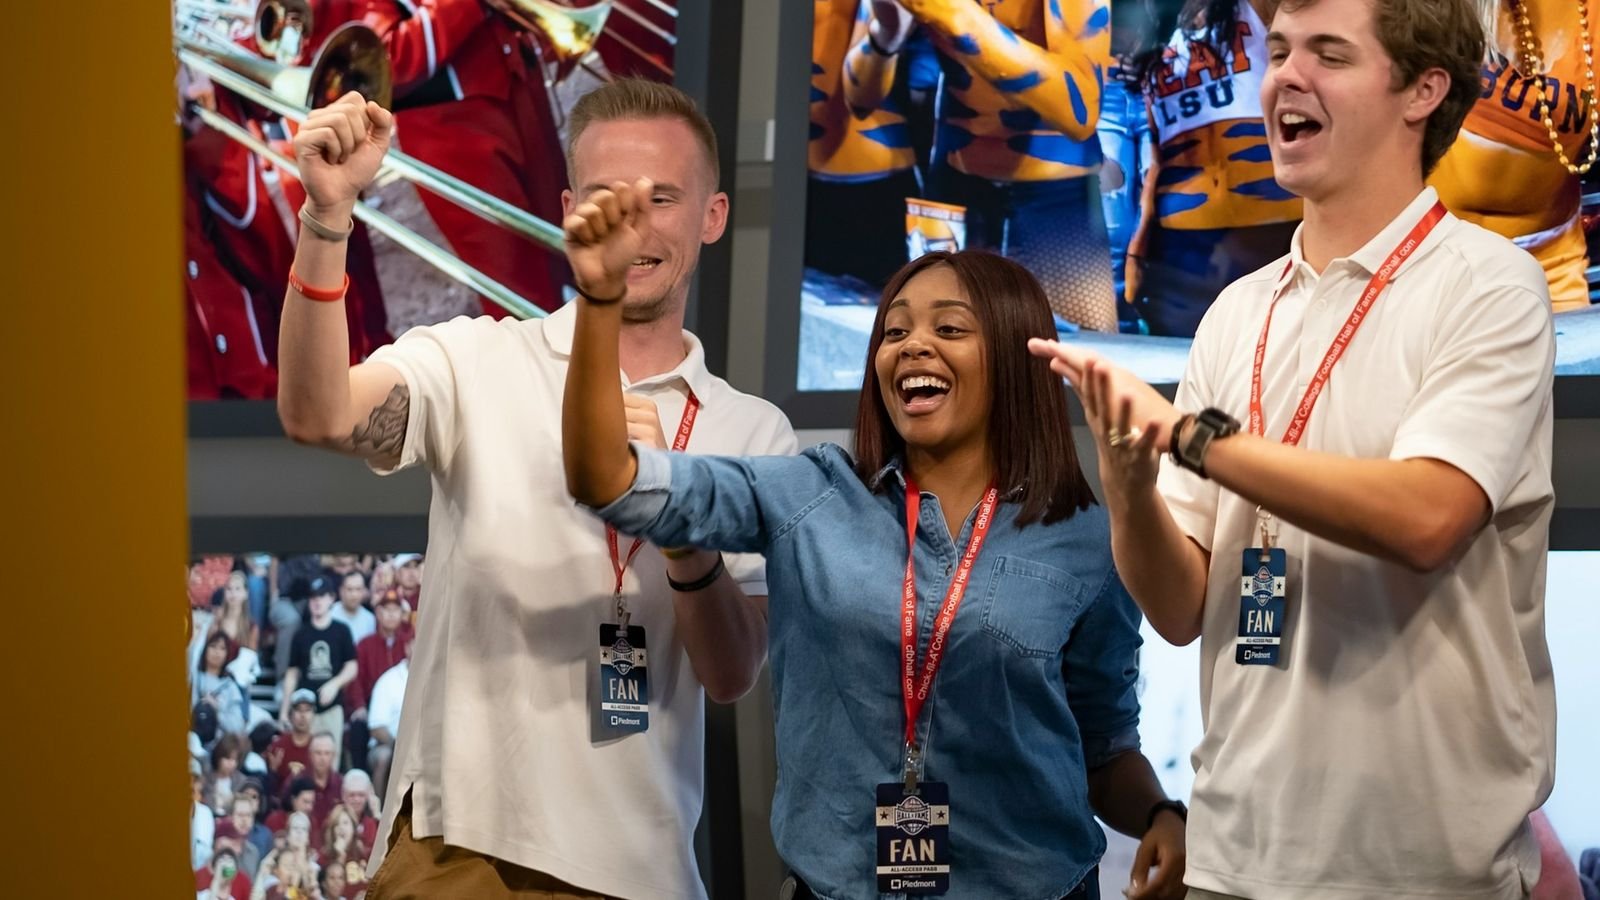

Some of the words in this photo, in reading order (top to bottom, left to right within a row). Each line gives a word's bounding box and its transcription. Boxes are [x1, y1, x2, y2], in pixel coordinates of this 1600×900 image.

[1158, 78, 1235, 127] LSU
[1298, 381, 1321, 417] College
[1316, 342, 1343, 380] Football
[1337, 324, 1354, 343] Hall
[1351, 313, 1361, 325] of
[1356, 287, 1378, 313] Fame
[1379, 239, 1416, 281] cfbhall.com
[905, 580, 914, 598] Hall
[932, 617, 951, 651] College
[943, 583, 963, 615] Football
[955, 568, 969, 584] Hall
[966, 536, 982, 559] Fame
[905, 600, 914, 609] of
[904, 610, 915, 637] Fame
[1246, 609, 1275, 634] FAN
[905, 644, 916, 699] cfbhall.com
[609, 678, 639, 702] FAN
[890, 838, 936, 863] FAN
[902, 880, 936, 889] Piedmont
